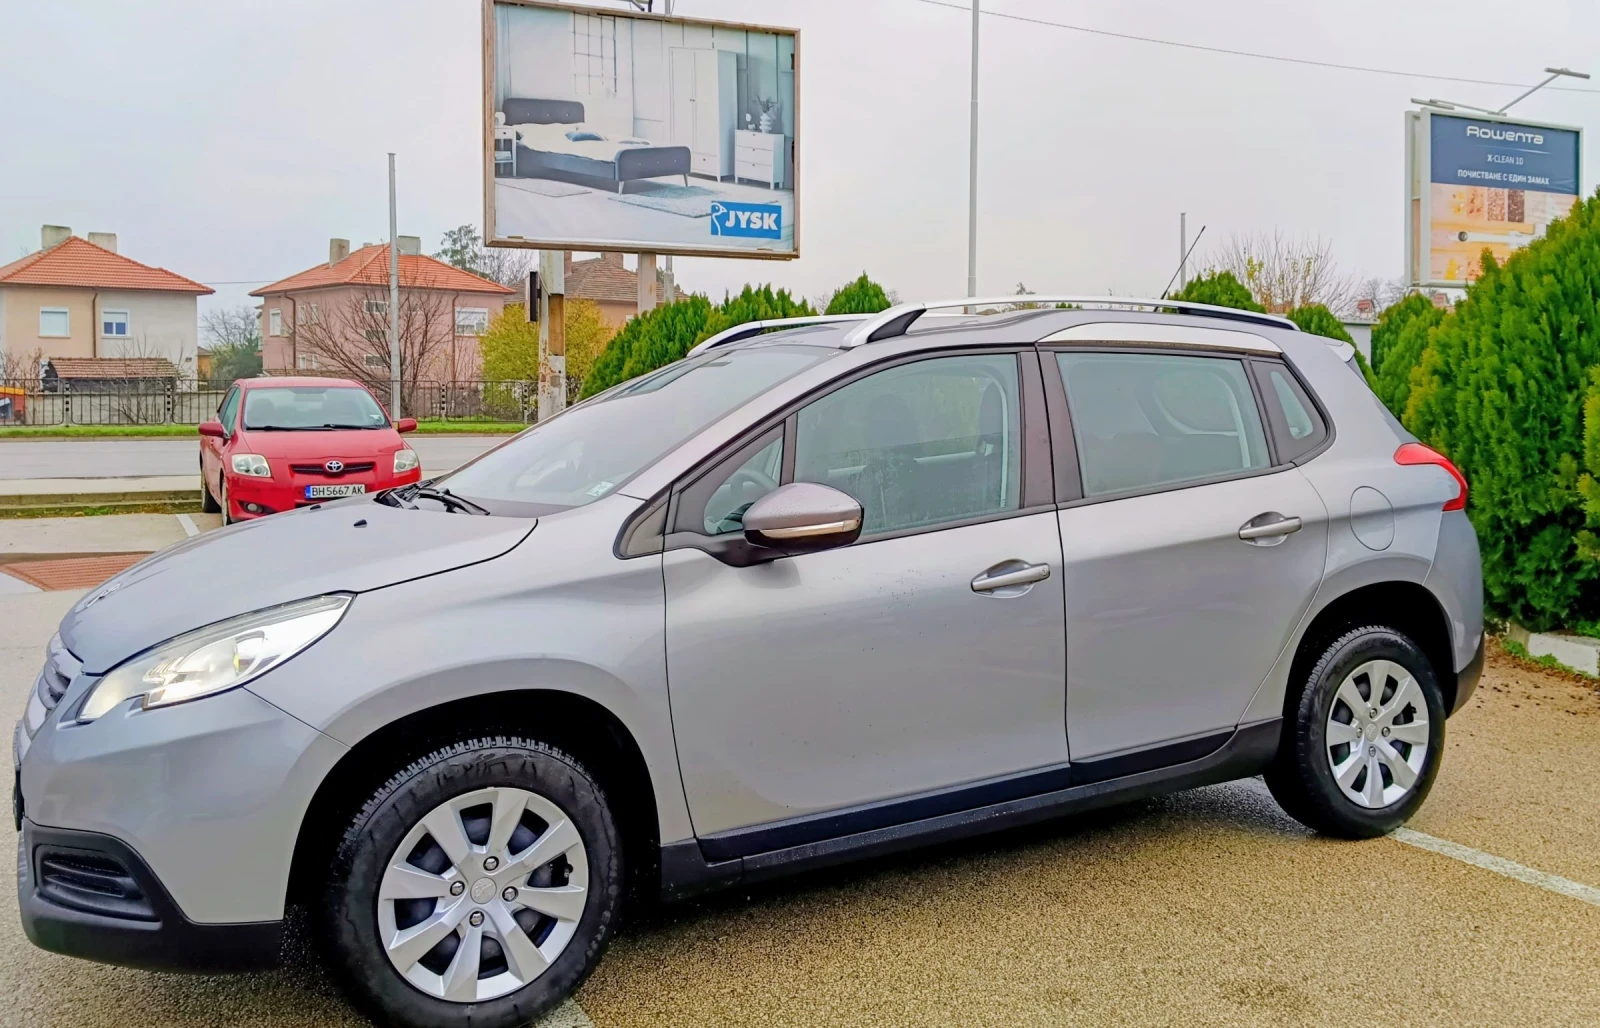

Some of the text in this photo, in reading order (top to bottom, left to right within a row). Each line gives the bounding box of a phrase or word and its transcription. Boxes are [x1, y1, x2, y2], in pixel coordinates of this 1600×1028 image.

[1487, 153, 1524, 165] X-CLEAN 10
[1457, 169, 1502, 180] ПОЧИСТВАНЕ
[1508, 173, 1526, 183] ЕДИН
[1527, 175, 1550, 185] ЗАМАХ
[725, 210, 778, 231] JYSK
